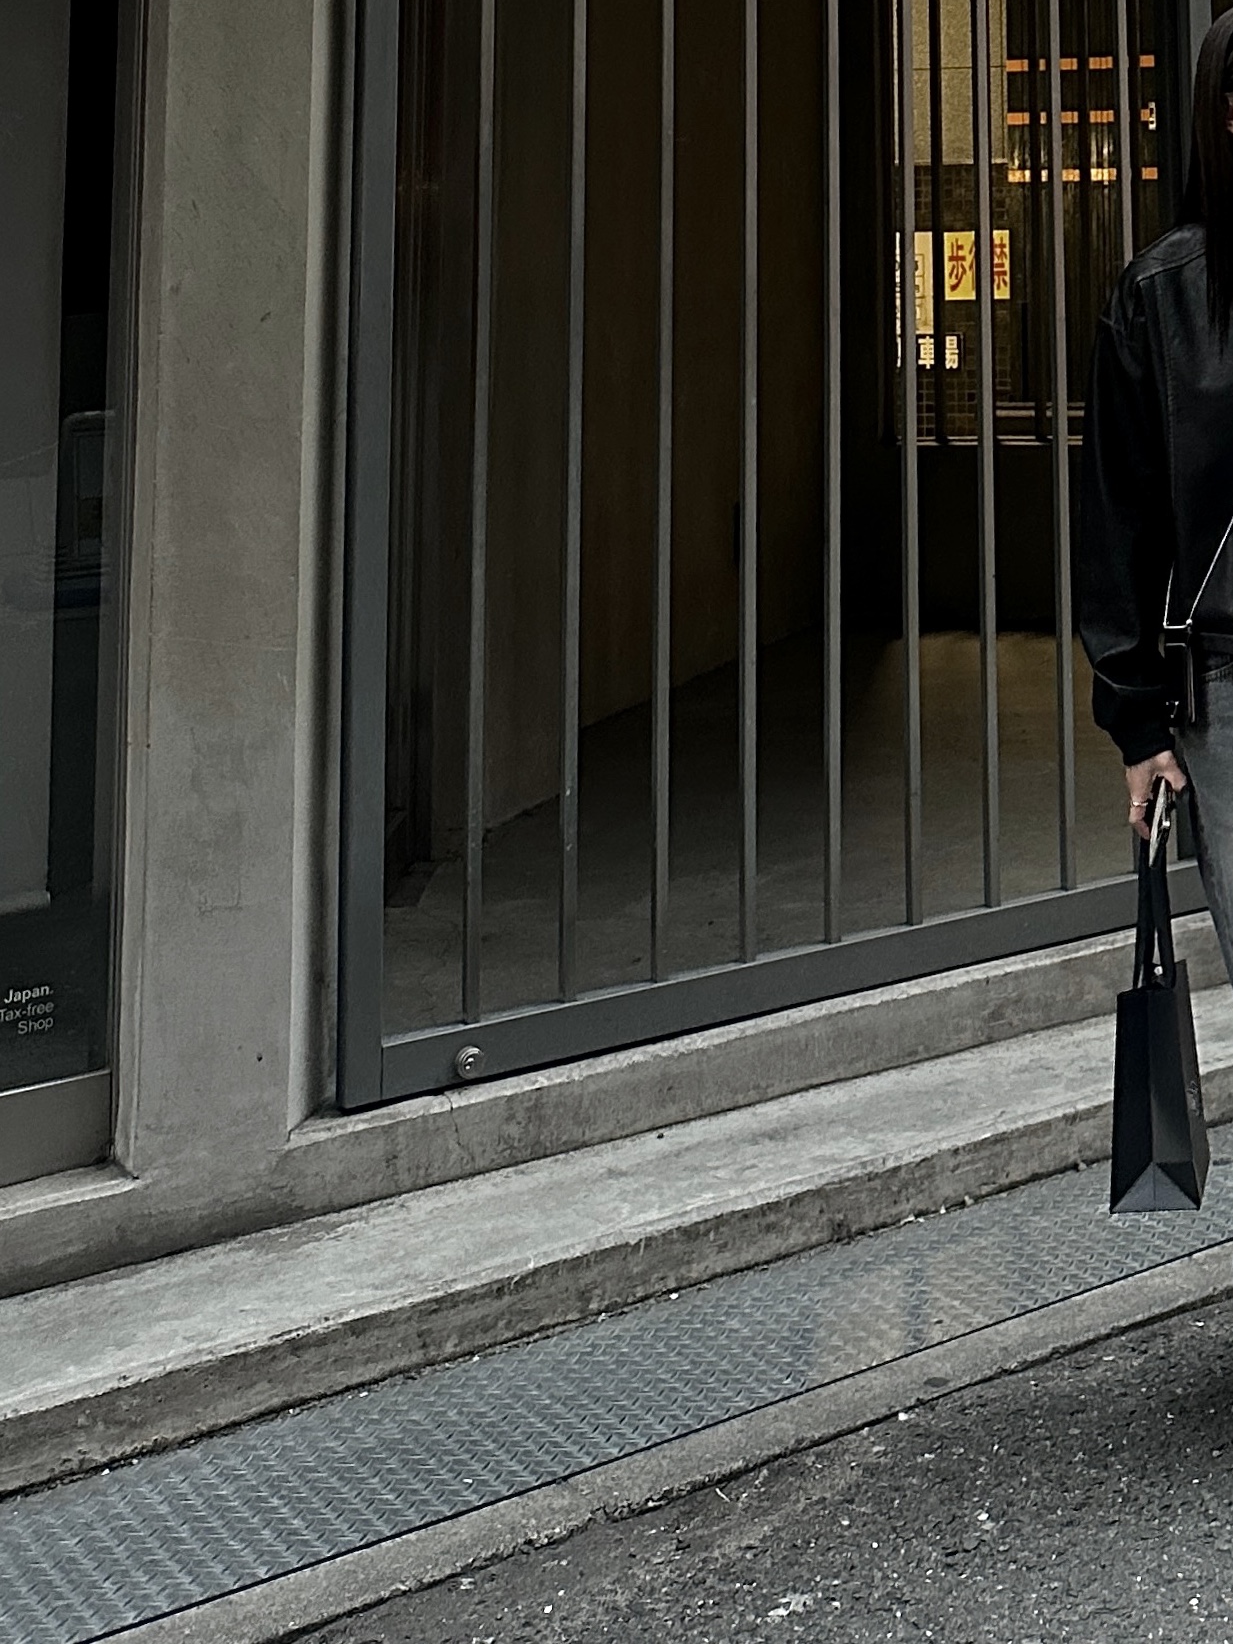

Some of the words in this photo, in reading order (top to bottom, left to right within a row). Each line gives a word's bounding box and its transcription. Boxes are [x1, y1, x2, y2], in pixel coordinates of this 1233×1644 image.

[4, 985, 54, 1003] Japan.
[0, 1002, 55, 1022] Tax-free
[17, 1017, 54, 1034] Shop
